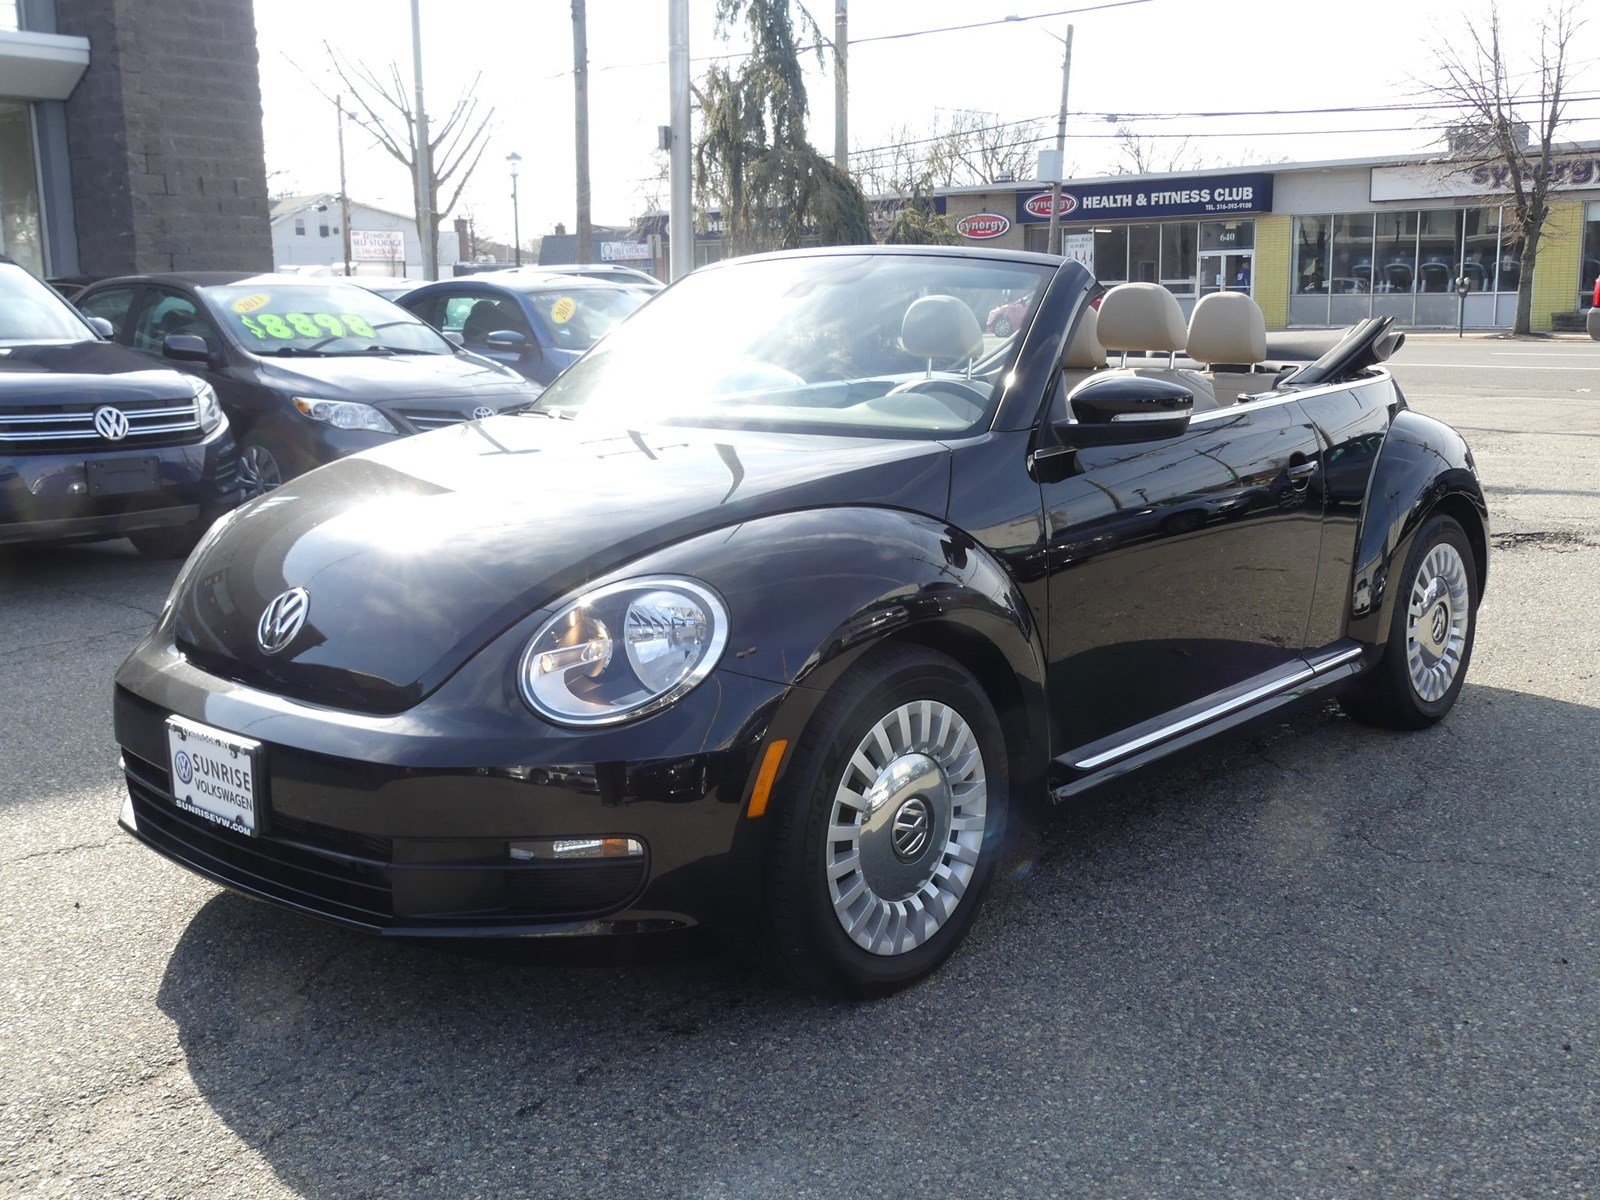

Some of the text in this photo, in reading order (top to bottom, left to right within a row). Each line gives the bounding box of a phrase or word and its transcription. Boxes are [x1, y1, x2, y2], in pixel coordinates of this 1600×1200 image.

[1082, 186, 1253, 209] HEALTH & FITNESS CLUB
[369, 239, 402, 247] STORAGE
[1219, 232, 1235, 242] 640
[241, 312, 378, 339] $8898
[192, 753, 252, 793] SUNRISE
[194, 778, 253, 813] VOLKSWAGEN
[175, 798, 251, 838] SUNRISEVW.COM
